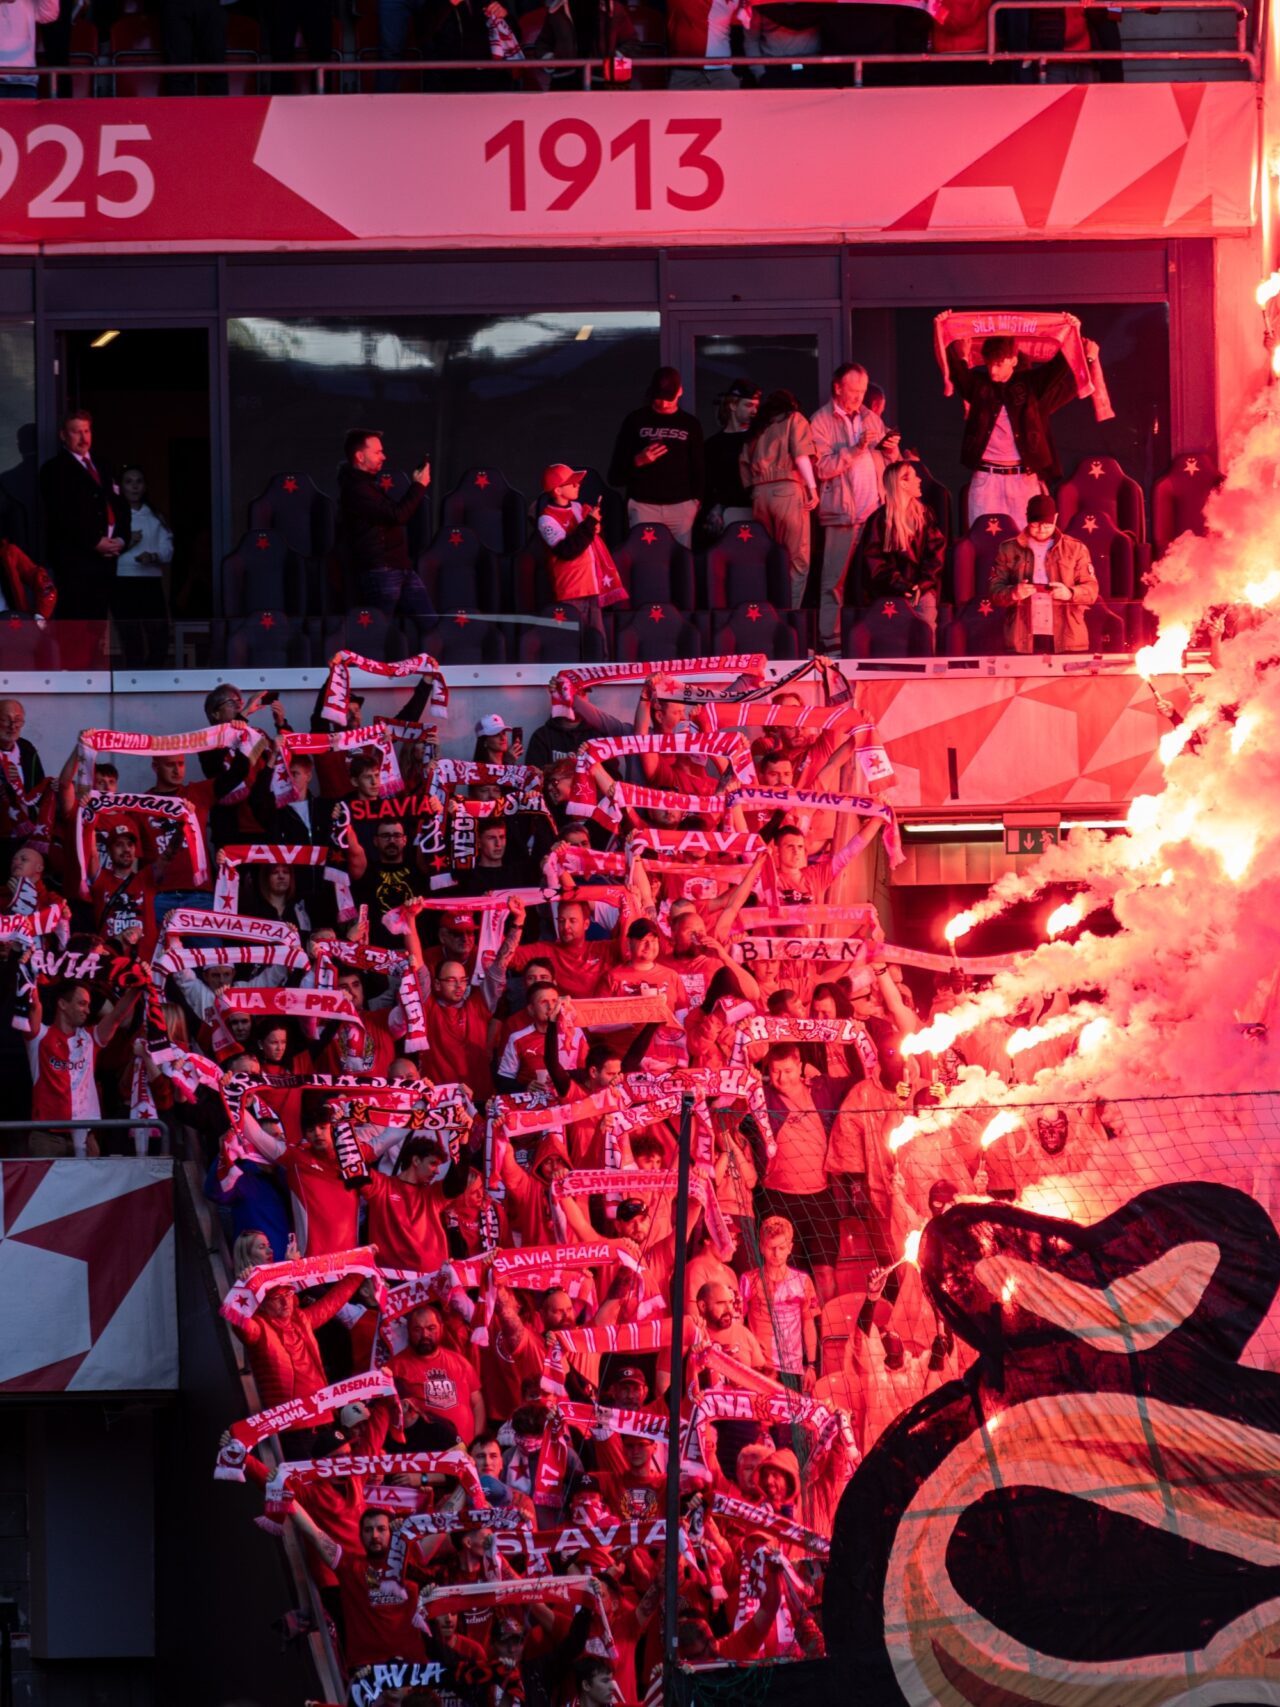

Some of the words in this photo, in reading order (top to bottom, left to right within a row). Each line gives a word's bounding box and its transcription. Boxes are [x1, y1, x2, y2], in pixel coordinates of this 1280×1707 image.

[484, 117, 725, 212] 1913
[639, 427, 689, 441] GUESS
[650, 655, 721, 673] SLAVIA
[597, 733, 678, 761] SLAVIA
[352, 796, 434, 820] SLAVIA
[178, 913, 244, 932] SLAVIA
[249, 921, 298, 945] PRAH
[742, 940, 865, 962] BICAN
[570, 1175, 626, 1190] SLAVIA
[626, 1174, 680, 1189] PRAHA
[493, 1250, 553, 1273] SLAVIA
[555, 1244, 611, 1263] PRAHA
[246, 1413, 264, 1428] SK
[264, 1398, 305, 1419] SLAVIA
[331, 1376, 382, 1398] ARSENAL
[268, 1407, 308, 1429] PRAHA
[711, 1491, 780, 1528] DERBY
[494, 1519, 668, 1555] SLAVIA
